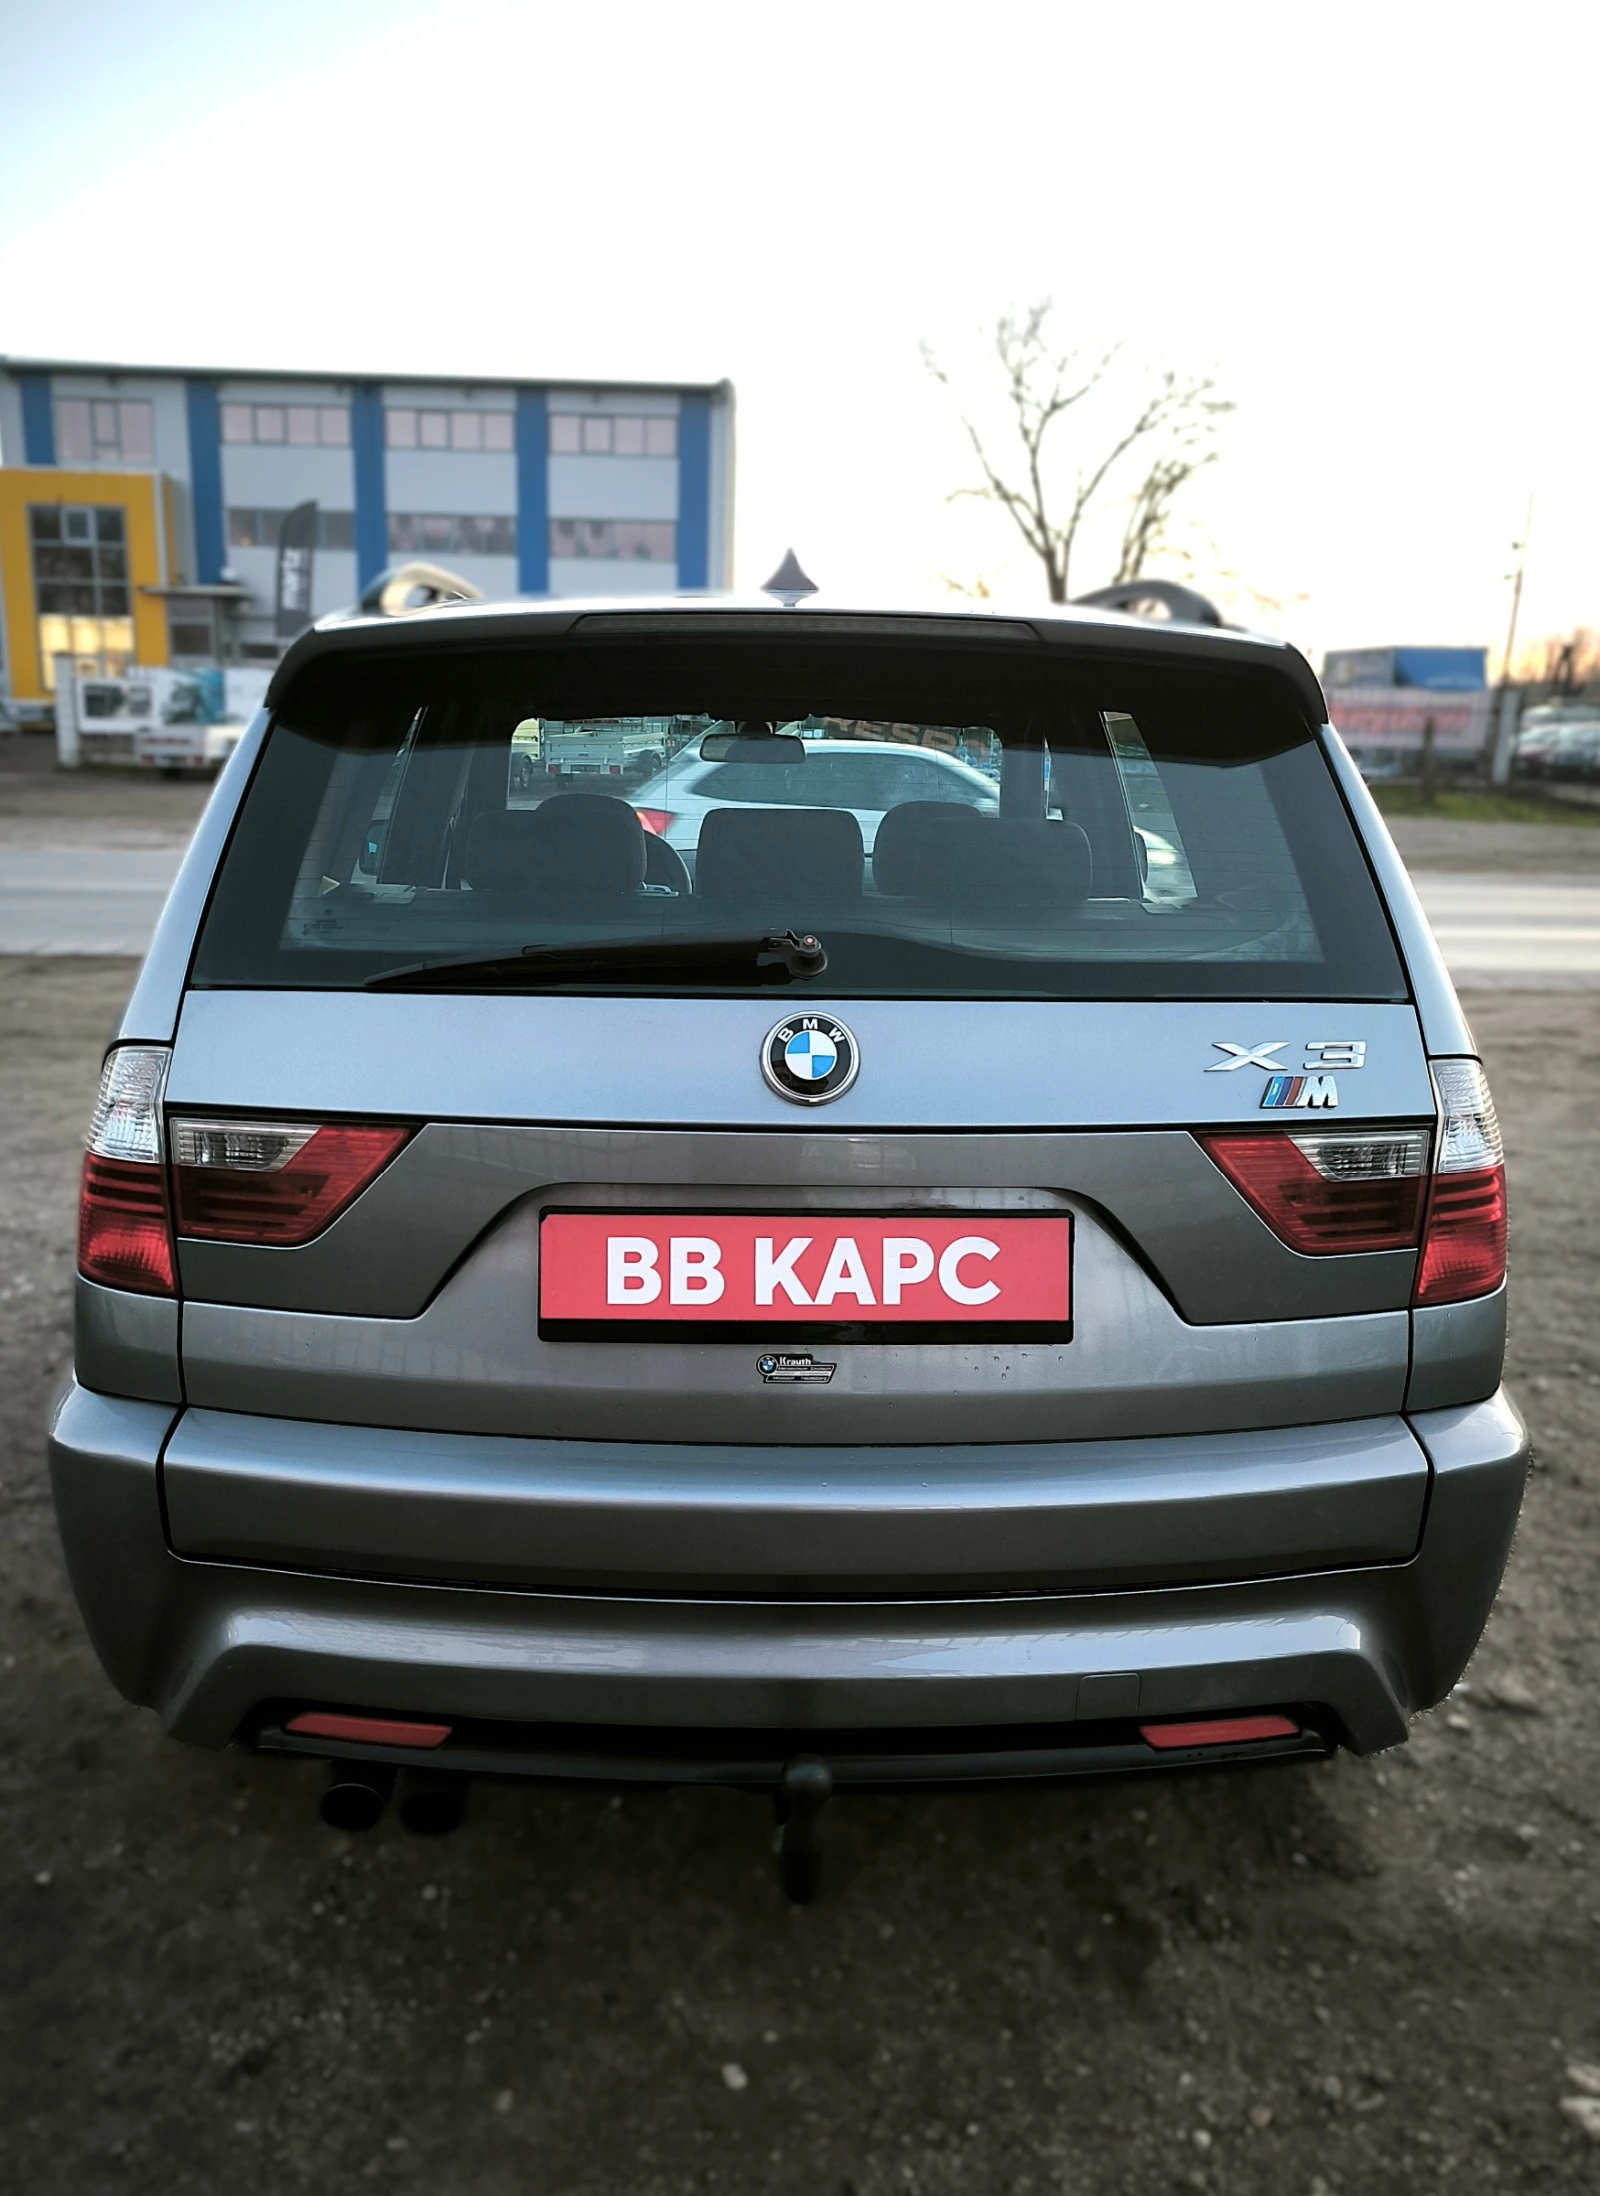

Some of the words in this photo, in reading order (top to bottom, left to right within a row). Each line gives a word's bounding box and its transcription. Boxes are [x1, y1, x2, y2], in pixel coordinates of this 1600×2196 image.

[777, 1018, 846, 1043] BMW
[1203, 1041, 1367, 1072] X3
[779, 1356, 811, 1365] Krauth
